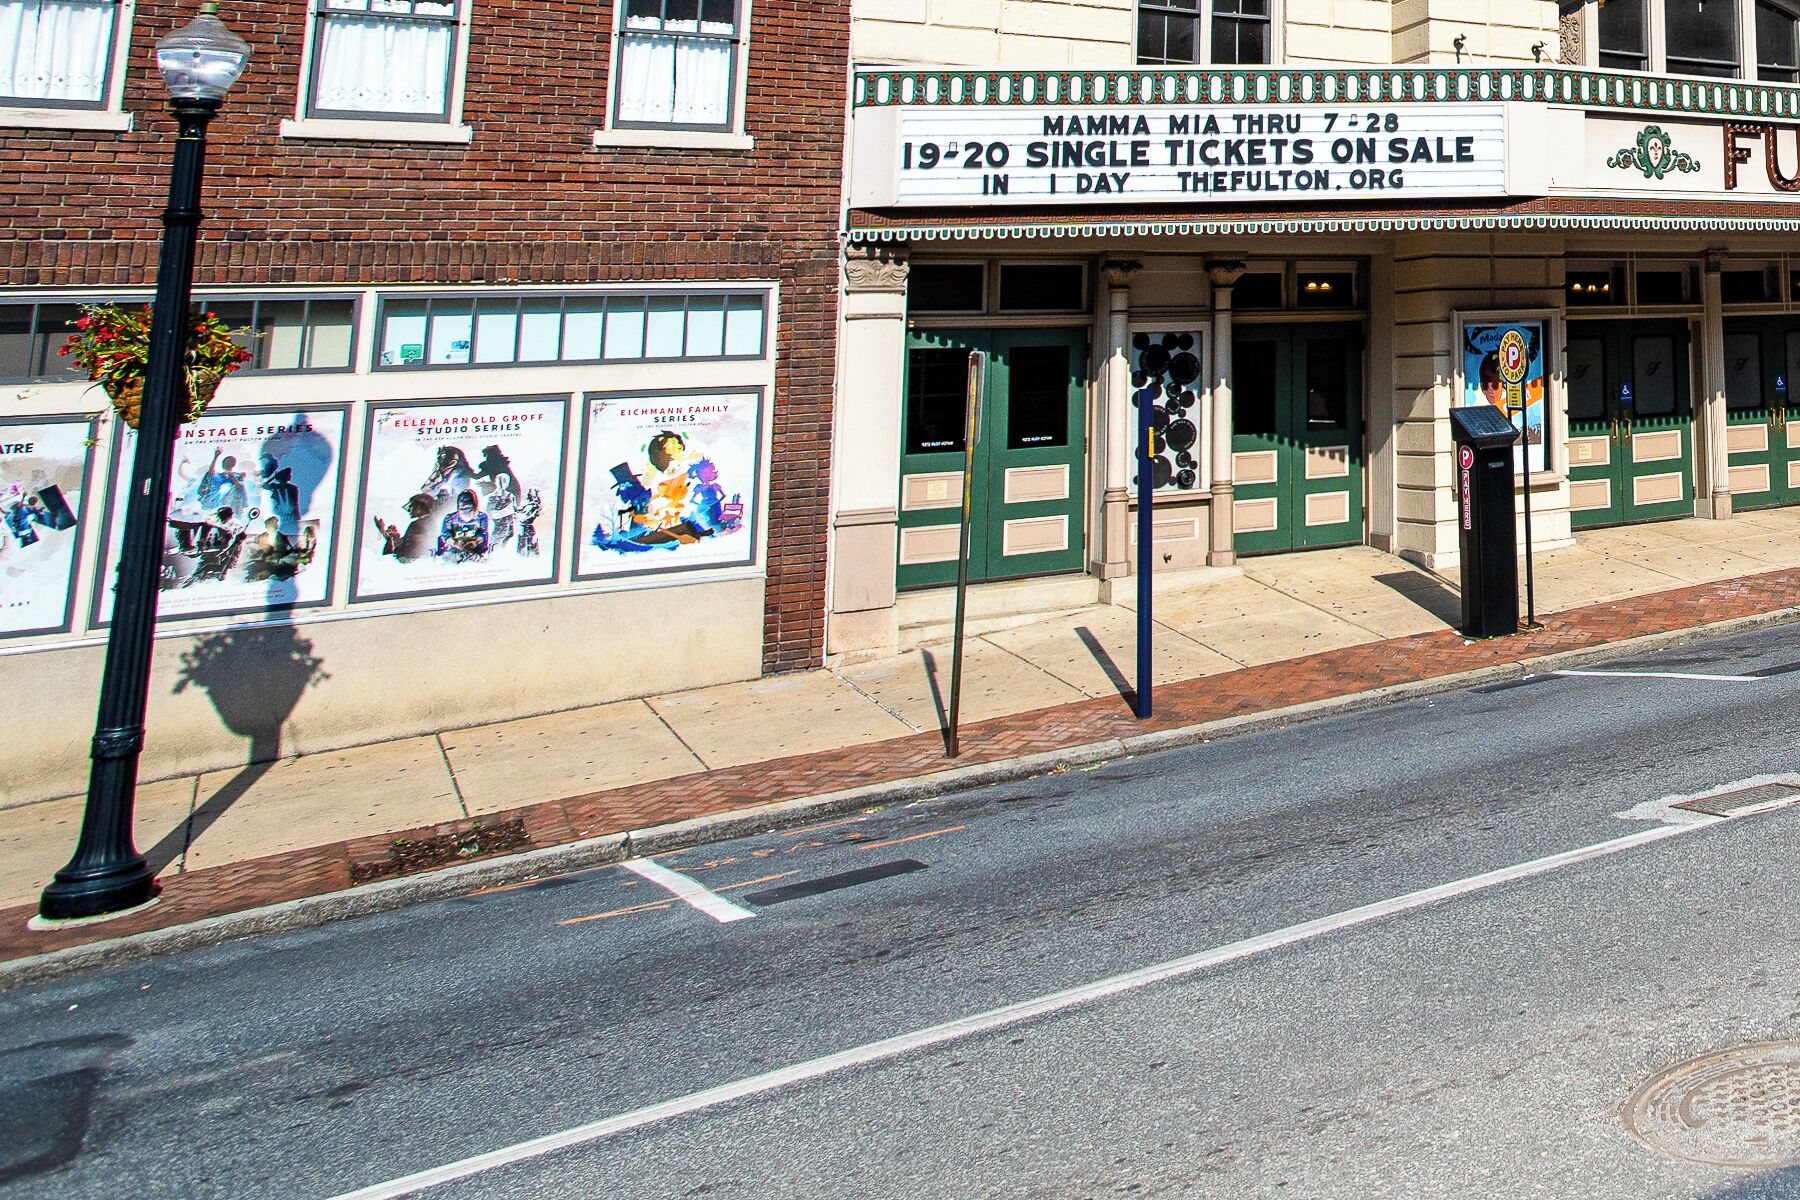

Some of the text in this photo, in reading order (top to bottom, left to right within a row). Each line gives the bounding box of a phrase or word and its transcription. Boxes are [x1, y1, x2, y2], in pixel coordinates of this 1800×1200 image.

[1043, 114, 1151, 136] MAMMA
[1169, 114, 1221, 135] MIA
[1233, 113, 1301, 134] THRU
[903, 136, 1475, 169] 19-20 SINGLE TICKETS ON SALE
[983, 174, 1009, 195] IN
[1076, 172, 1130, 194] DAY
[1508, 346, 1519, 367] P
[620, 405, 729, 416] EICHMANN FAMILY
[394, 413, 545, 427] ELLEN ARNOLD GROFF
[654, 414, 696, 423] SERIES
[256, 423, 314, 435] SERIES
[417, 423, 521, 435] STUDIO SERIES
[1462, 450, 1469, 465] P
